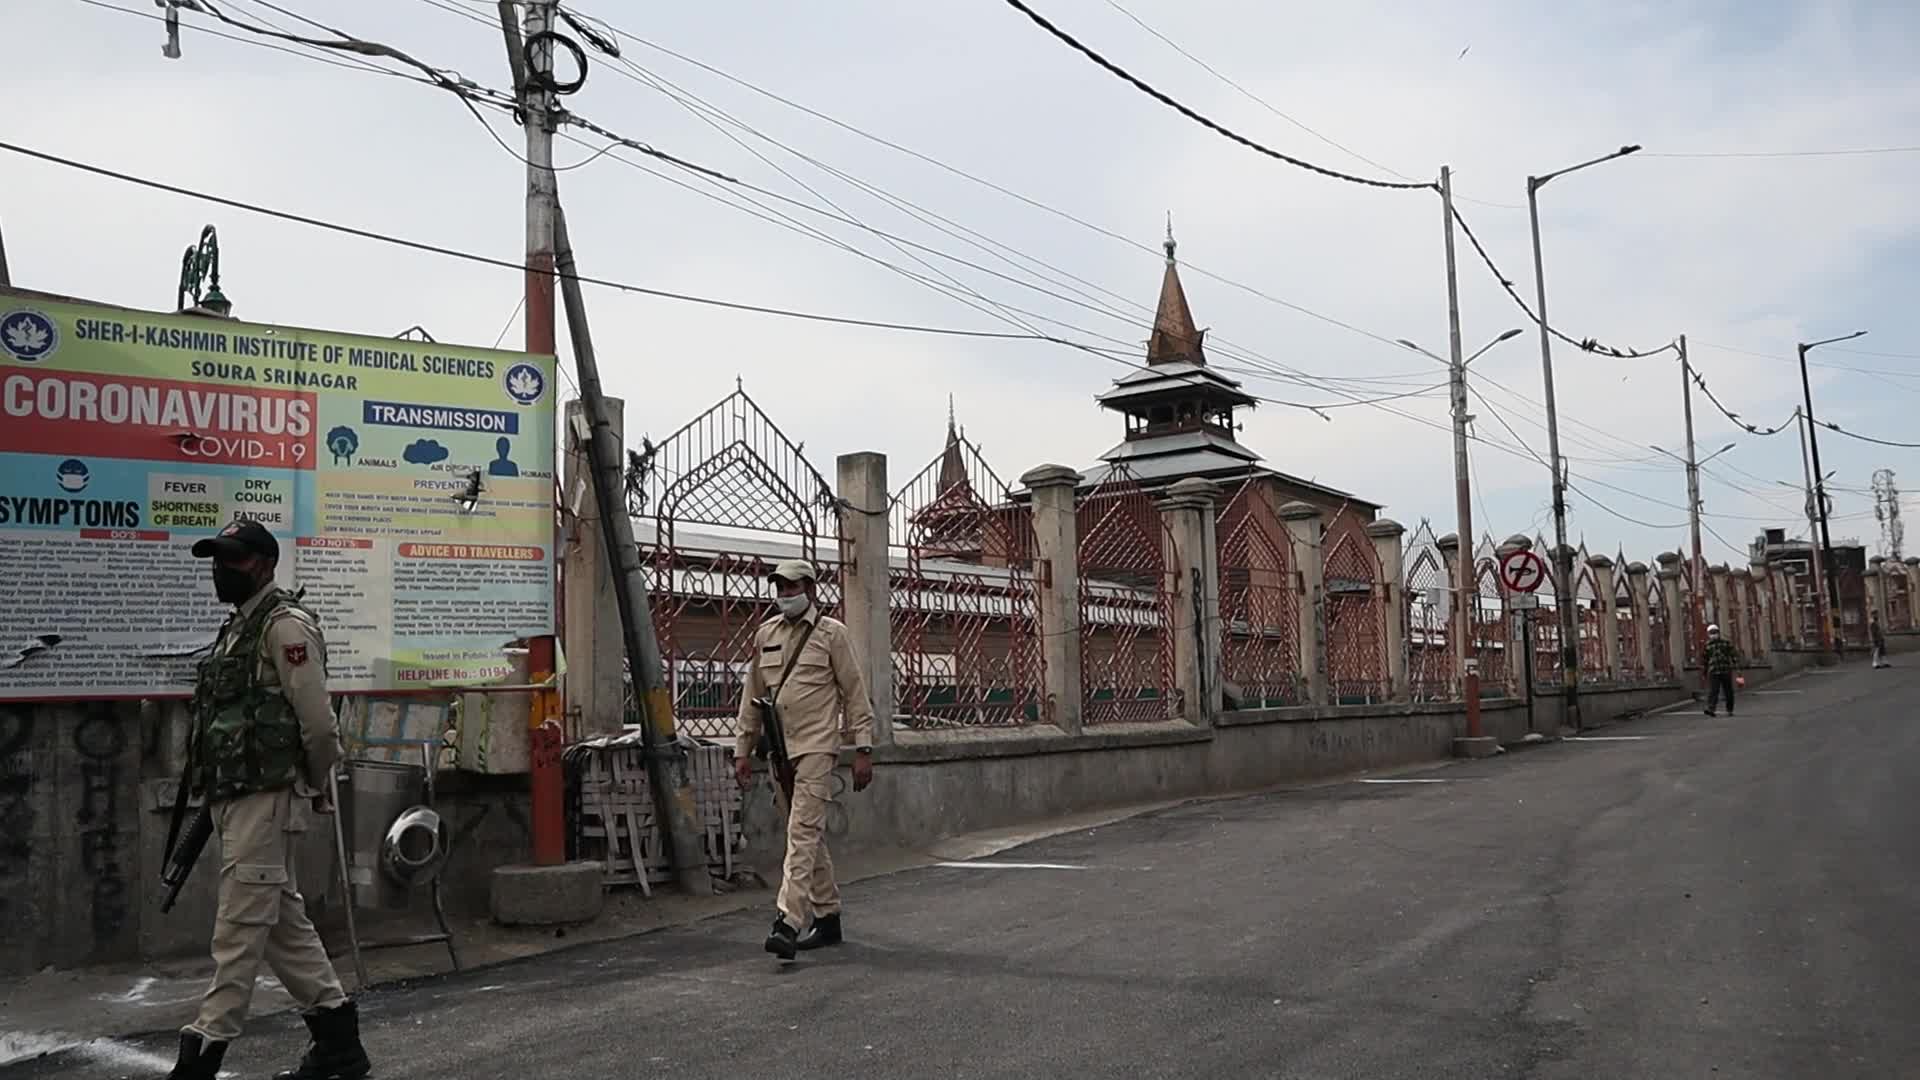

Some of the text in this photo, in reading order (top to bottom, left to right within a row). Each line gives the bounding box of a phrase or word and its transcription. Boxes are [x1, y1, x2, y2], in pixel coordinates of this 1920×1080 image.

[76, 319, 494, 378] SHER-I-KASHMIR INSTITUTE OF MEDICAL SCIENCES
[192, 361, 358, 391] SOURA SRINAGAR
[4, 375, 310, 438] CORONAVIRUS
[372, 405, 506, 432] TRANSMISSION
[180, 436, 306, 463] COVID-19
[357, 458, 397, 468] ANIMALS
[431, 464, 444, 472] AIR
[521, 470, 552, 479] HUMANS
[164, 481, 206, 494] FEVER
[245, 479, 271, 490] DRY
[414, 480, 475, 491] PREVENTI
[235, 492, 282, 504] COUGH
[0, 496, 139, 527] SYMPTOMS
[152, 500, 219, 513] SHORTNESS
[154, 515, 216, 527] OF BREATH
[234, 511, 282, 523] FATIGUE
[409, 545, 534, 560] ADVICE TO TRAVELLERS
[398, 668, 448, 681] HELPLINE
